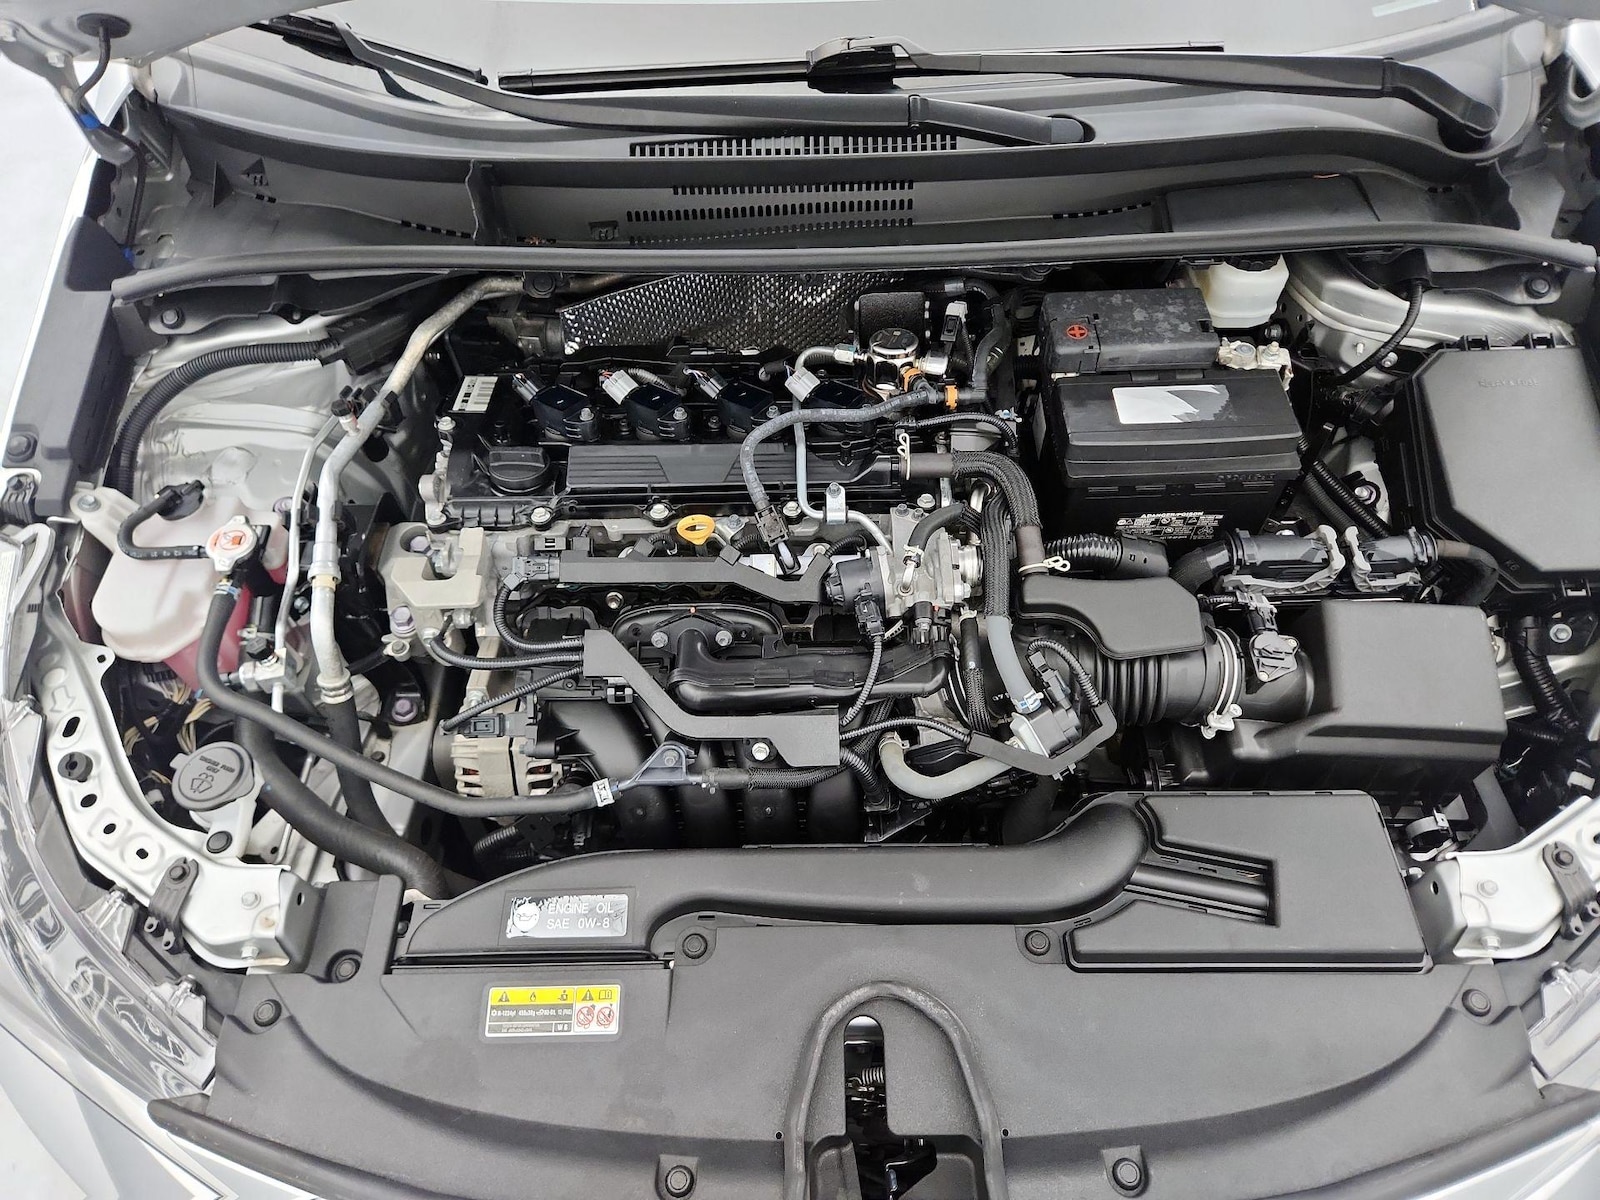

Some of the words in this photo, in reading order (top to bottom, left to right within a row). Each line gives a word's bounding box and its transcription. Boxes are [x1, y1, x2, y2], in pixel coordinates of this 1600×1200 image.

[548, 902, 588, 914] ENGINE
[596, 902, 614, 914] OIL
[546, 918, 569, 929] SAE
[578, 918, 610, 929] 0W-8
